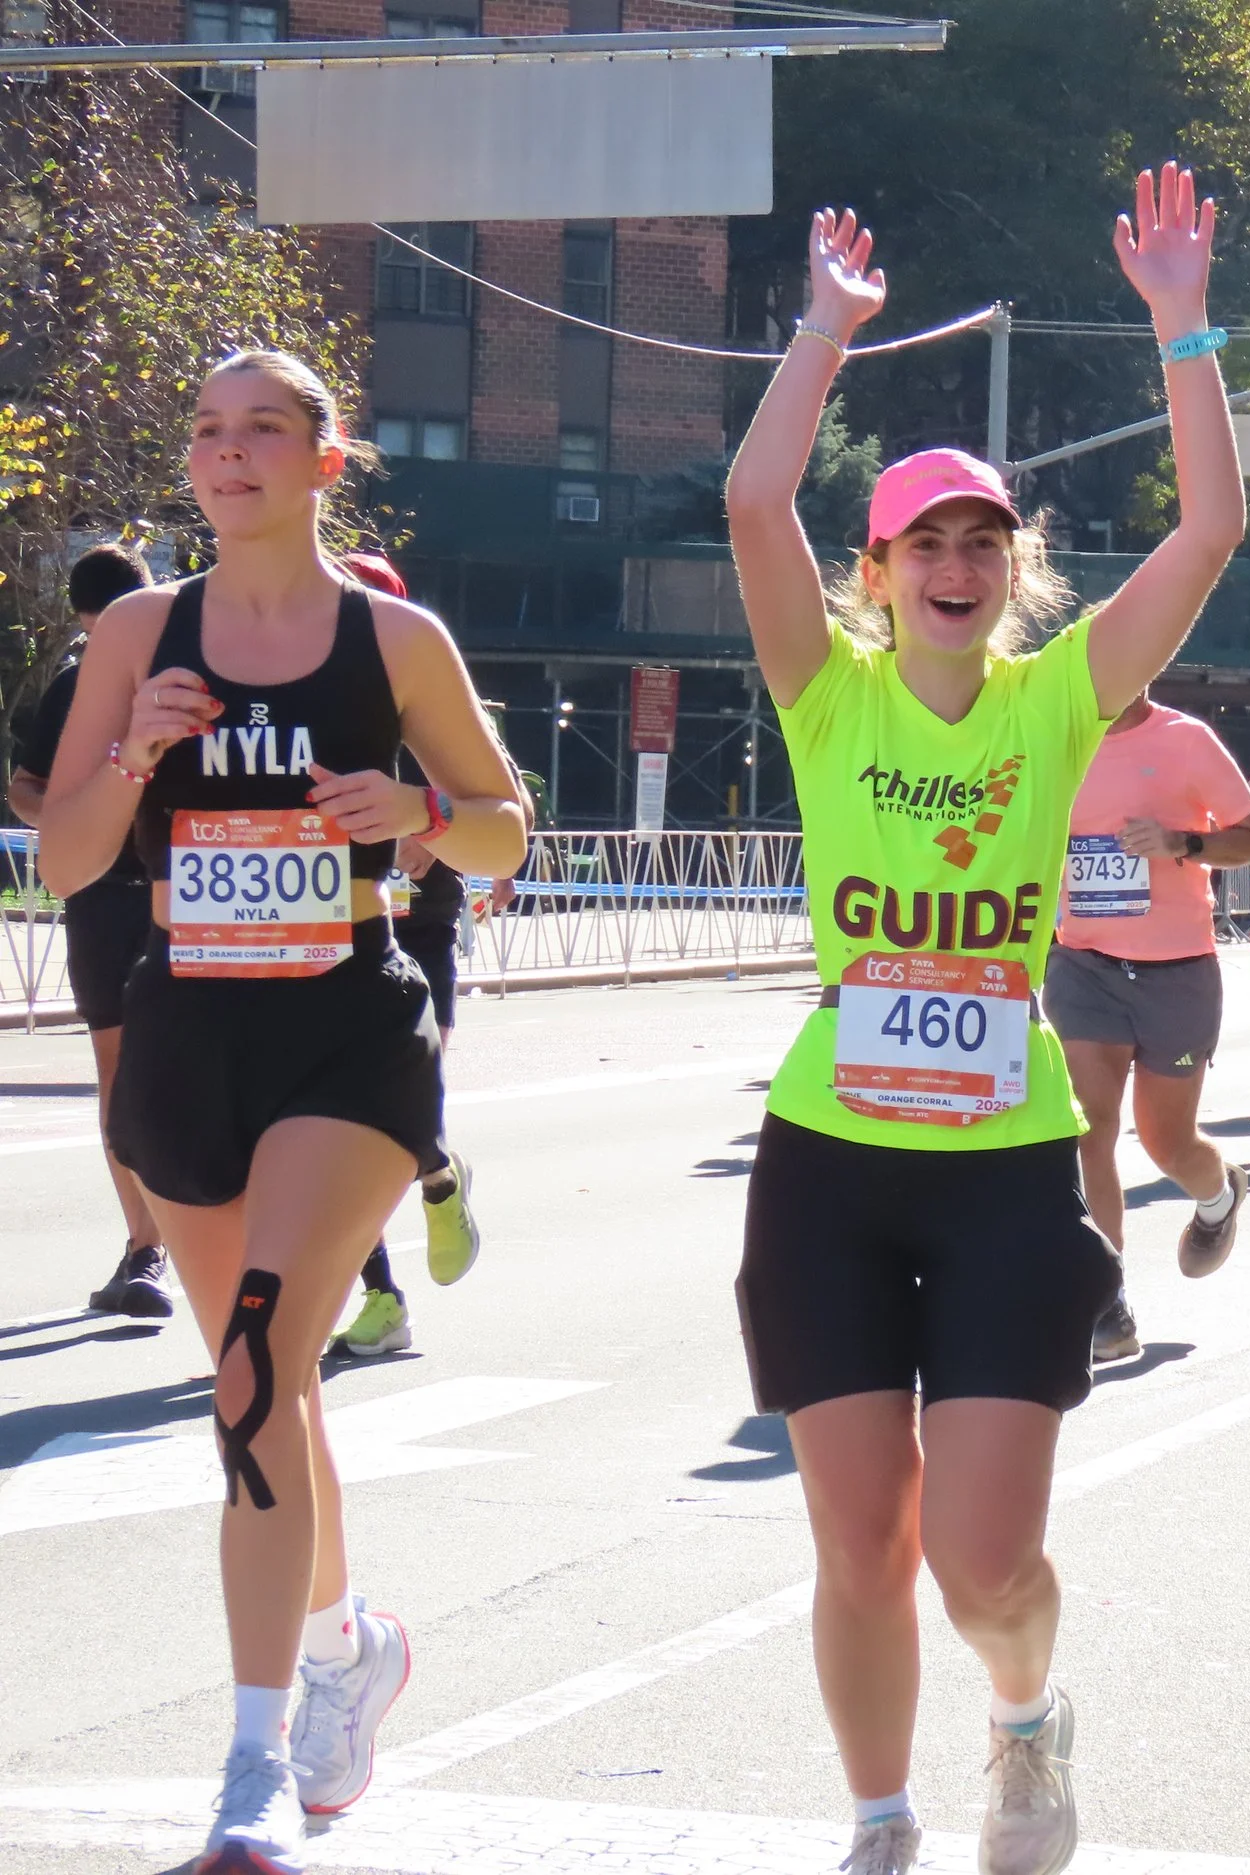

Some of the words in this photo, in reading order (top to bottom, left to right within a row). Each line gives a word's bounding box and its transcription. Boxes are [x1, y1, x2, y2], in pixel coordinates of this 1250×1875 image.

[202, 725, 315, 777] NYLA
[191, 818, 227, 842] tcs
[228, 818, 251, 826] TATA
[298, 832, 326, 841] TATA
[1071, 840, 1088, 852] tcs
[1071, 855, 1140, 881] 37437
[179, 851, 341, 903] 38300
[234, 908, 280, 921] NYLA
[833, 875, 1042, 950] GUIDE
[196, 948, 204, 959] 3
[209, 951, 243, 959] ORANGE
[280, 948, 287, 959] F
[303, 947, 337, 959] 2025
[866, 957, 904, 983] tcs
[910, 959, 935, 968] TATA
[909, 967, 966, 980] CONSULTANCY
[908, 976, 945, 986] SERVICES
[980, 982, 1008, 993] TATA
[880, 994, 987, 1052] 460
[1003, 1080, 1020, 1088] AWD
[878, 1095, 915, 1104] ORANGE
[916, 1097, 953, 1106] CORRAL
[976, 1099, 1010, 1111] 2025
[242, 1295, 265, 1309] KT
